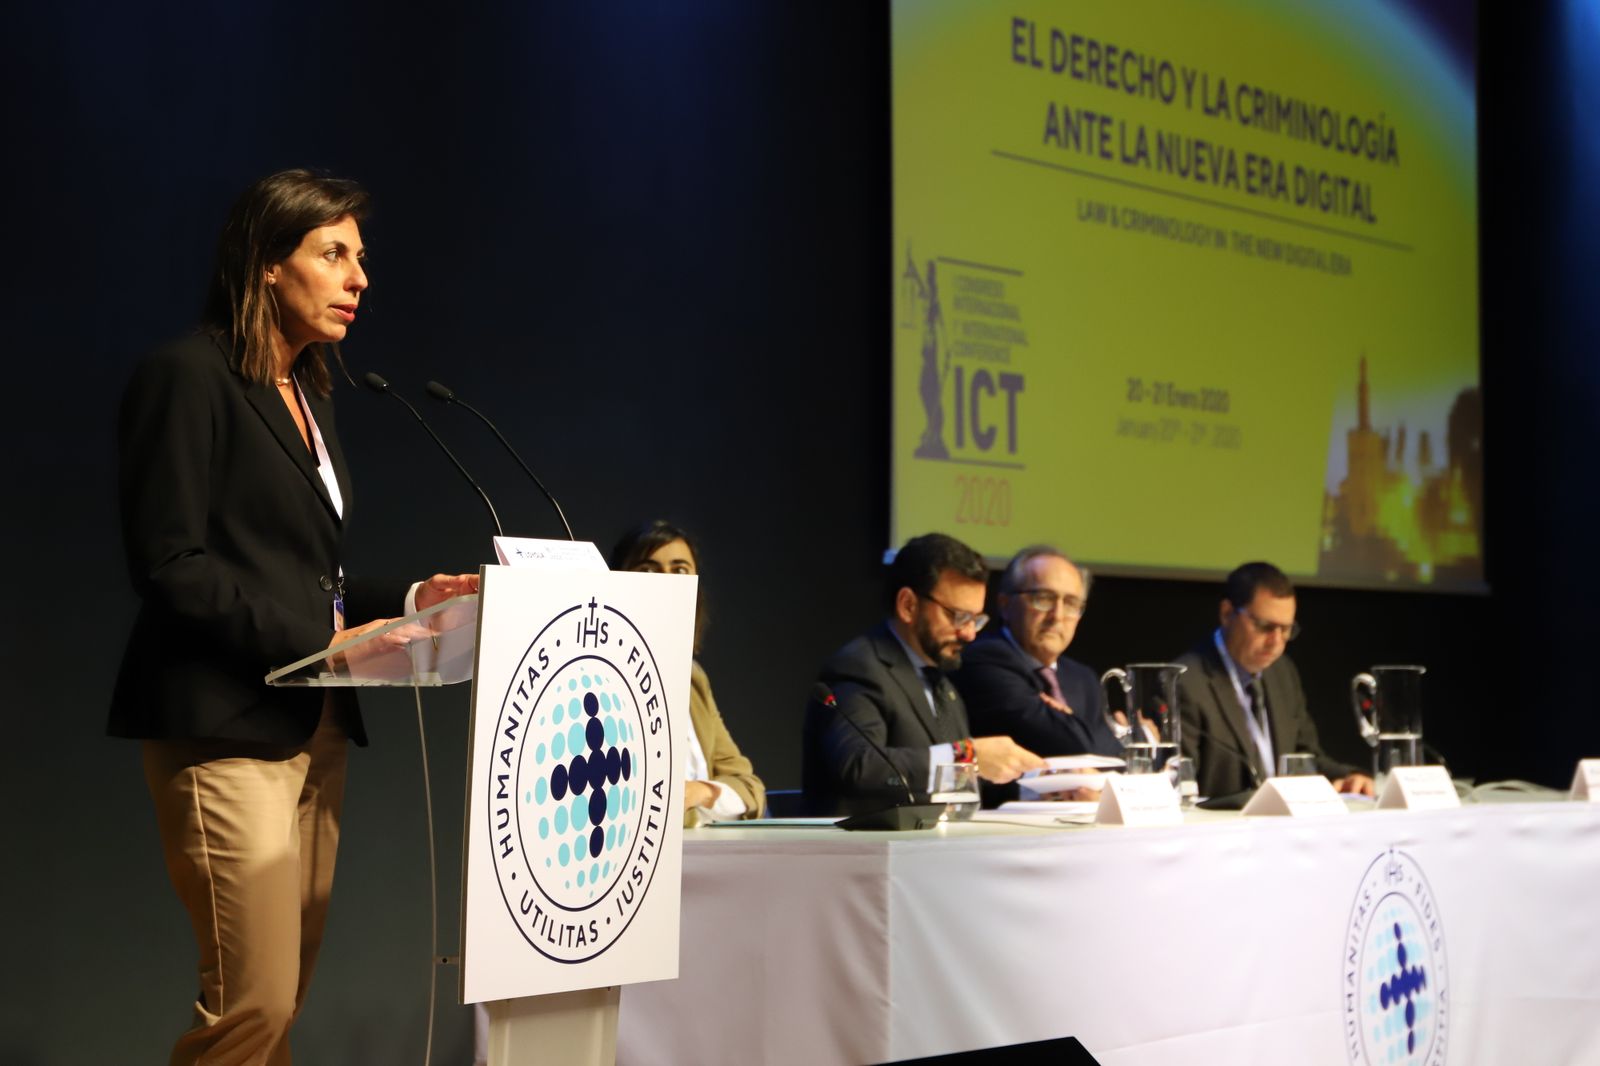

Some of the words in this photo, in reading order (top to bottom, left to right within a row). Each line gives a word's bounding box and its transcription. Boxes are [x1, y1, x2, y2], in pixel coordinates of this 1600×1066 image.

[1011, 16, 1043, 69] EL
[1050, 28, 1177, 105] DERECHO
[1181, 66, 1198, 110] Y
[1203, 73, 1231, 121] LA
[1236, 83, 1399, 166] CRIMINOLOGÍA
[1043, 101, 1114, 160] ANTE
[1120, 120, 1151, 170] LA
[1156, 130, 1240, 191] NUEVA
[1245, 153, 1290, 203] ERA
[1295, 166, 1377, 224] DIGITAL
[955, 365, 1024, 455] ICT
[955, 474, 1011, 526] 2020
[576, 616, 609, 648] IHS
[627, 645, 661, 736] FIDES
[497, 647, 550, 859] HUMANITAS
[616, 779, 664, 916] IUSTITIA
[520, 889, 599, 948] UTILITAS
